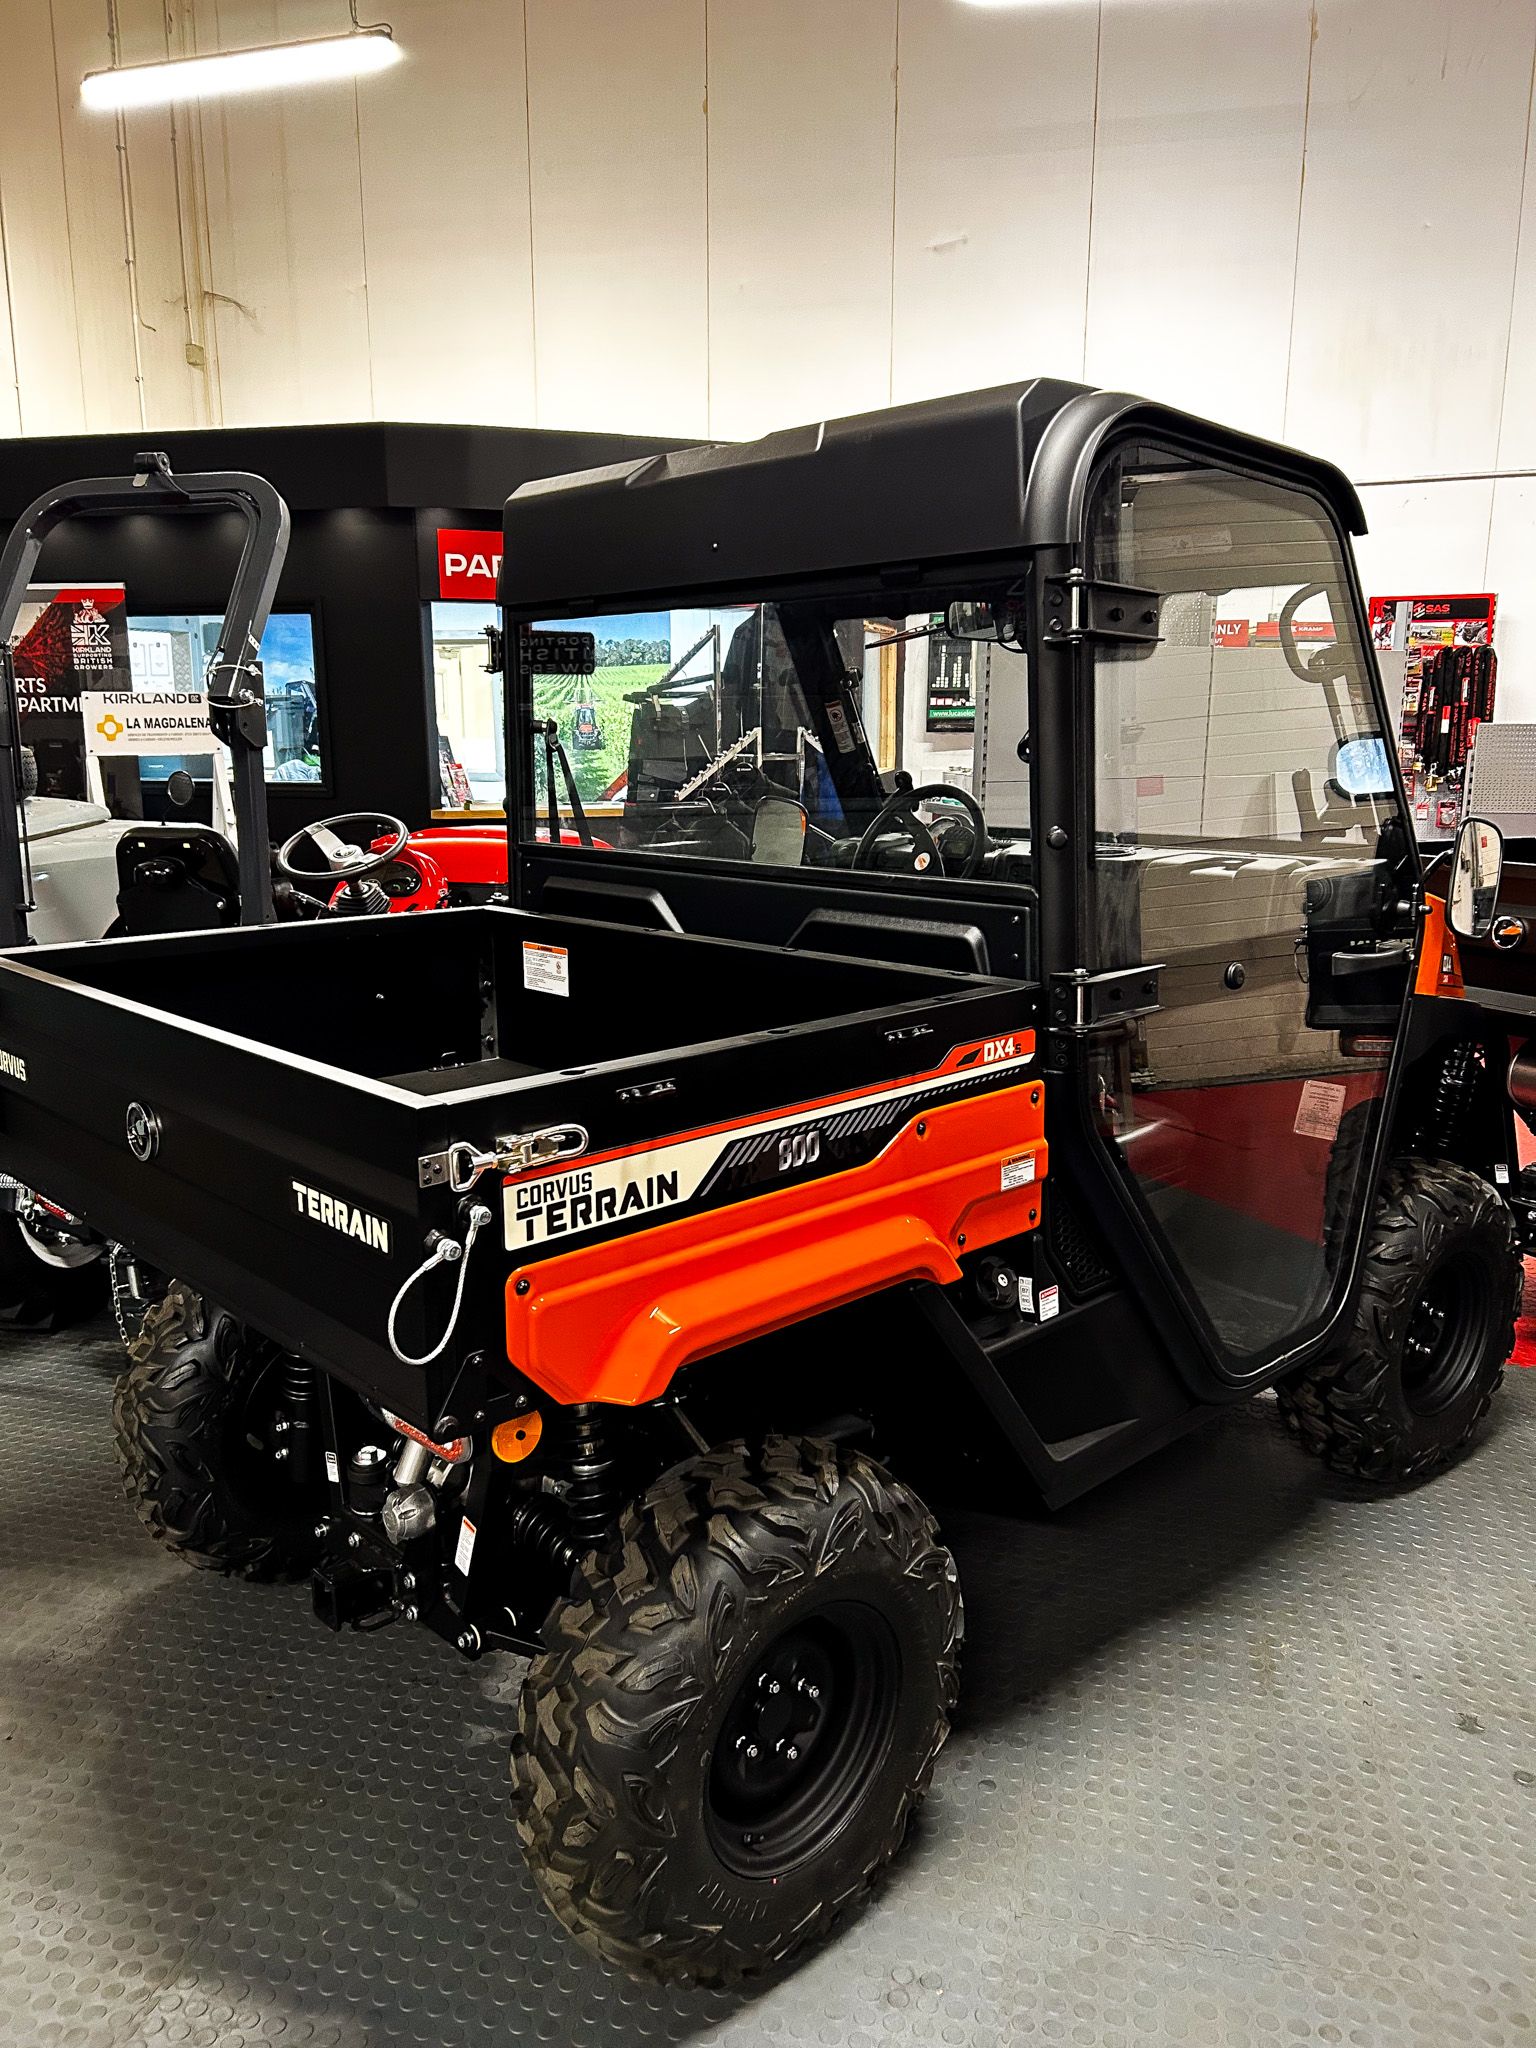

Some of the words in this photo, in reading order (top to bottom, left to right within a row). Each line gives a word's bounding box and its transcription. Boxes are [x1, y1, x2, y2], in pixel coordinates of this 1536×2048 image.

[1425, 603, 1451, 613] SAS
[1215, 623, 1242, 635] NLY
[103, 693, 187, 704] KIRKLAND
[126, 717, 141, 729] LA
[144, 717, 211, 729] MAGDALENA
[778, 1131, 820, 1172] 800
[516, 1171, 593, 1209] CORVUS
[292, 1180, 389, 1254] TERRAIN
[516, 1170, 679, 1242] TERRAIN
